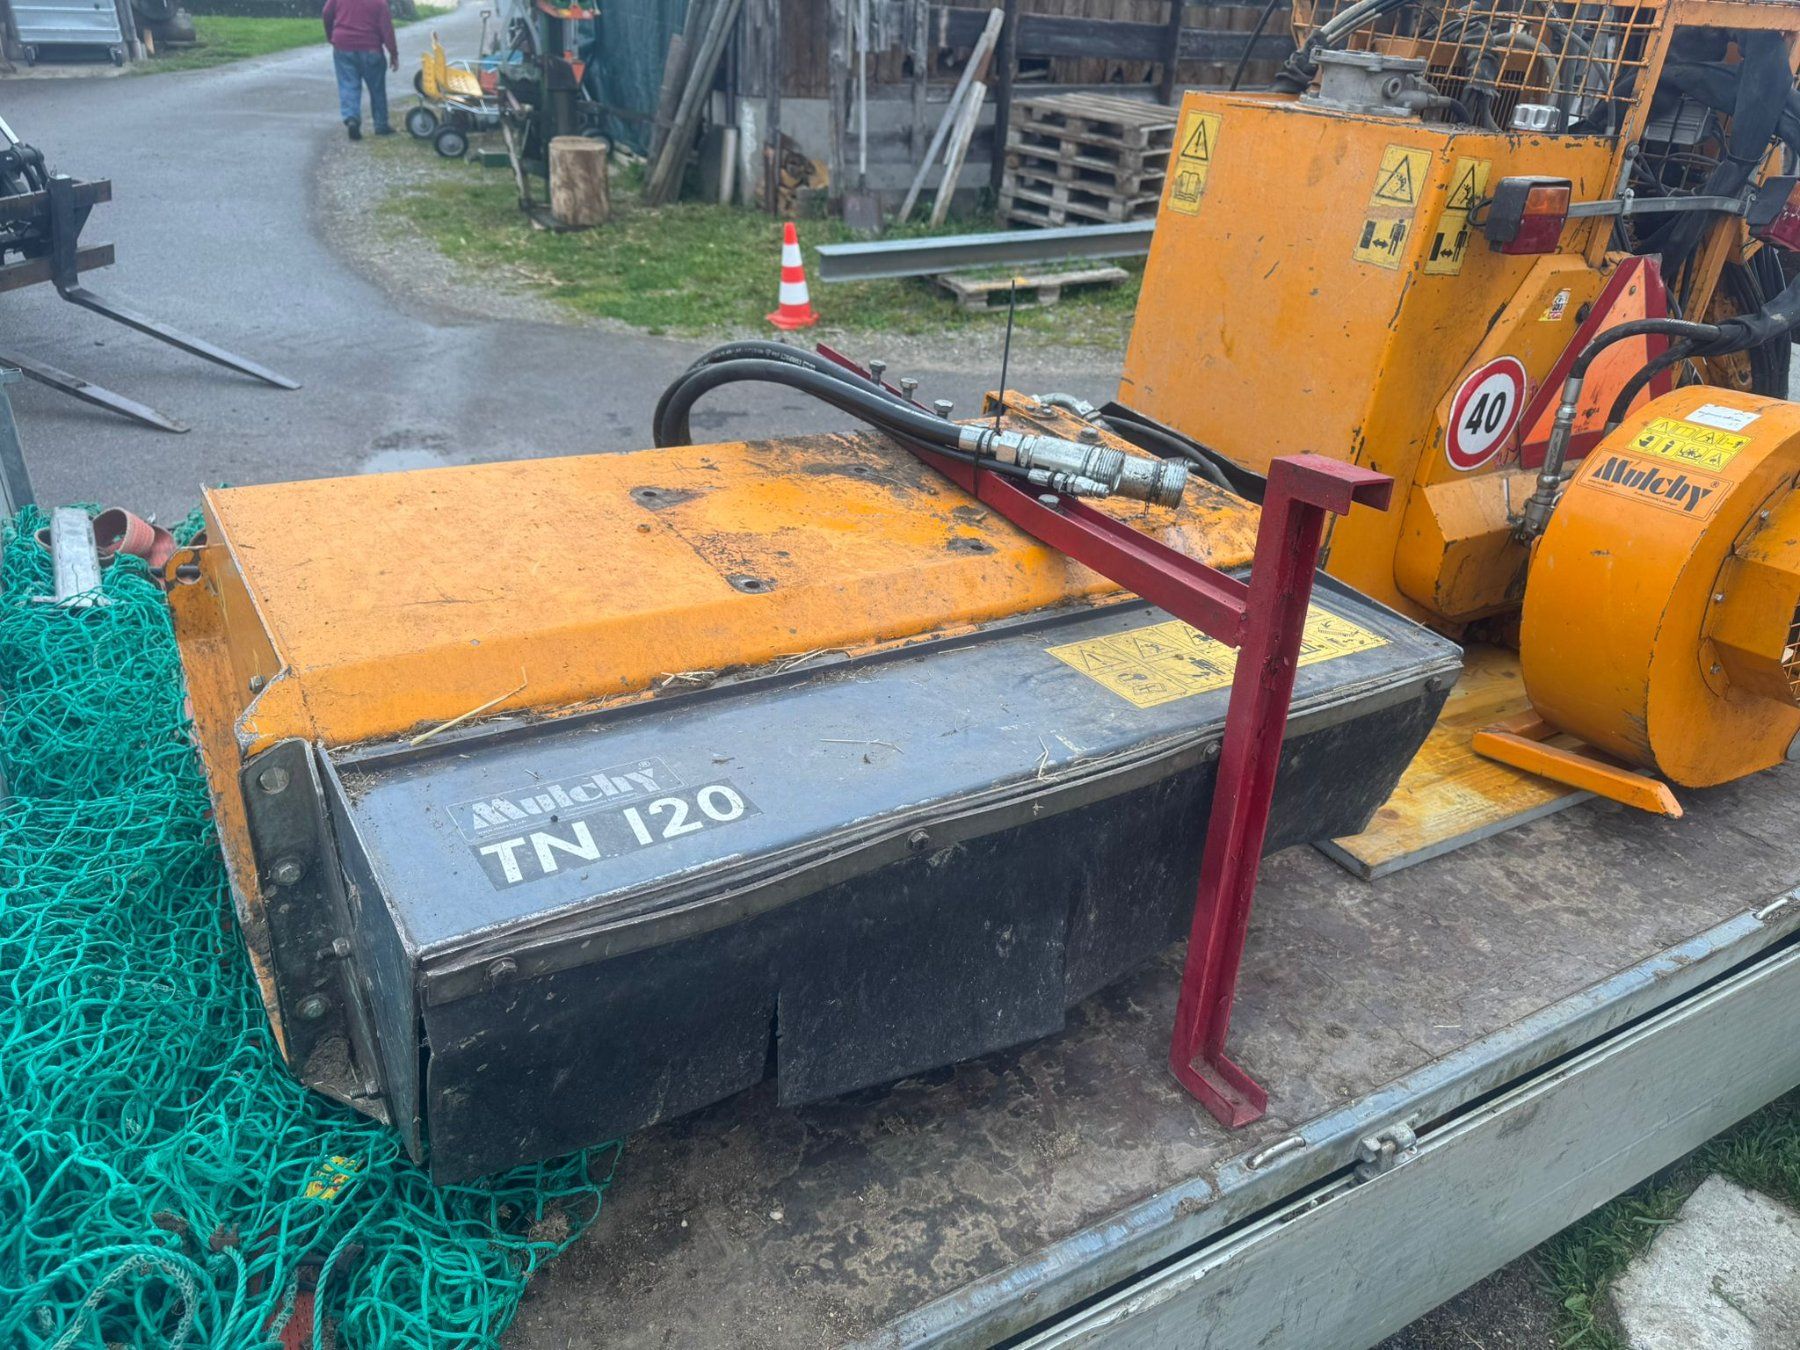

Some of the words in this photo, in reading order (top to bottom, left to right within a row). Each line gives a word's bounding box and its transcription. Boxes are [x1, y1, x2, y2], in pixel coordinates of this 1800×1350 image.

[1465, 391, 1506, 435] 40
[480, 821, 601, 884] TN
[623, 785, 745, 846] 120
